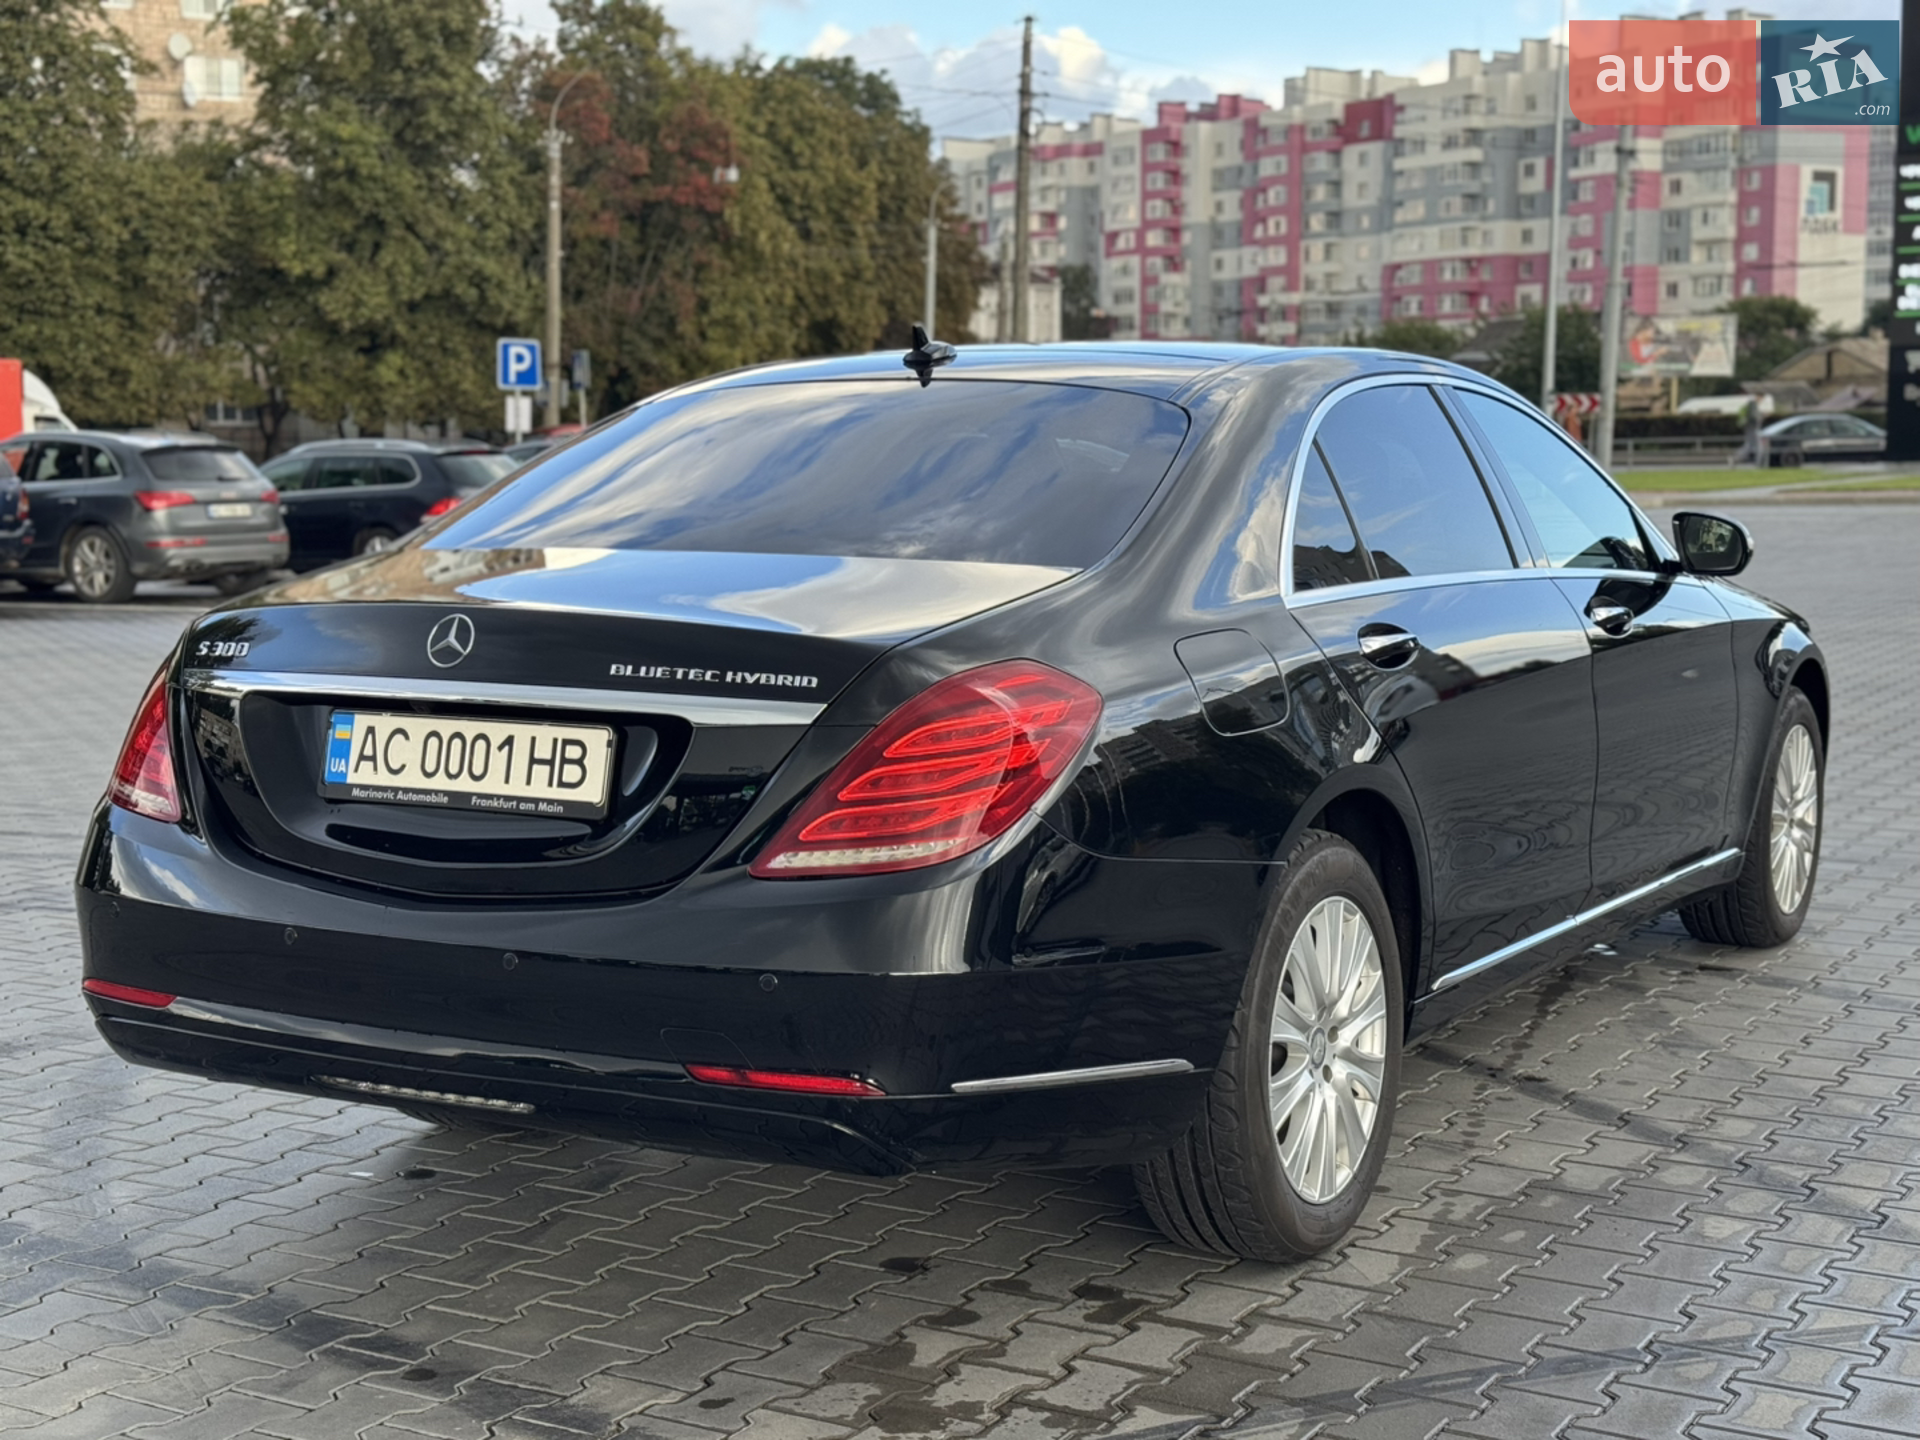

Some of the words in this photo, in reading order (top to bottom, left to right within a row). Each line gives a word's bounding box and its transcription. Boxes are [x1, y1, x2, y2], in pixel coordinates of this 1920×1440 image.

[508, 345, 533, 384] P
[195, 640, 211, 656] S
[209, 641, 250, 657] 300
[609, 663, 721, 683] BLUETEC
[725, 671, 818, 688] HYBRID
[330, 757, 347, 774] UA
[353, 725, 410, 776] AC
[420, 729, 515, 785] 0001
[525, 735, 588, 790] HB
[351, 787, 394, 800] Marinovic
[396, 790, 449, 804] Automobile
[471, 795, 517, 809] Frankfurt
[519, 801, 535, 811] am
[537, 801, 564, 813] Main
